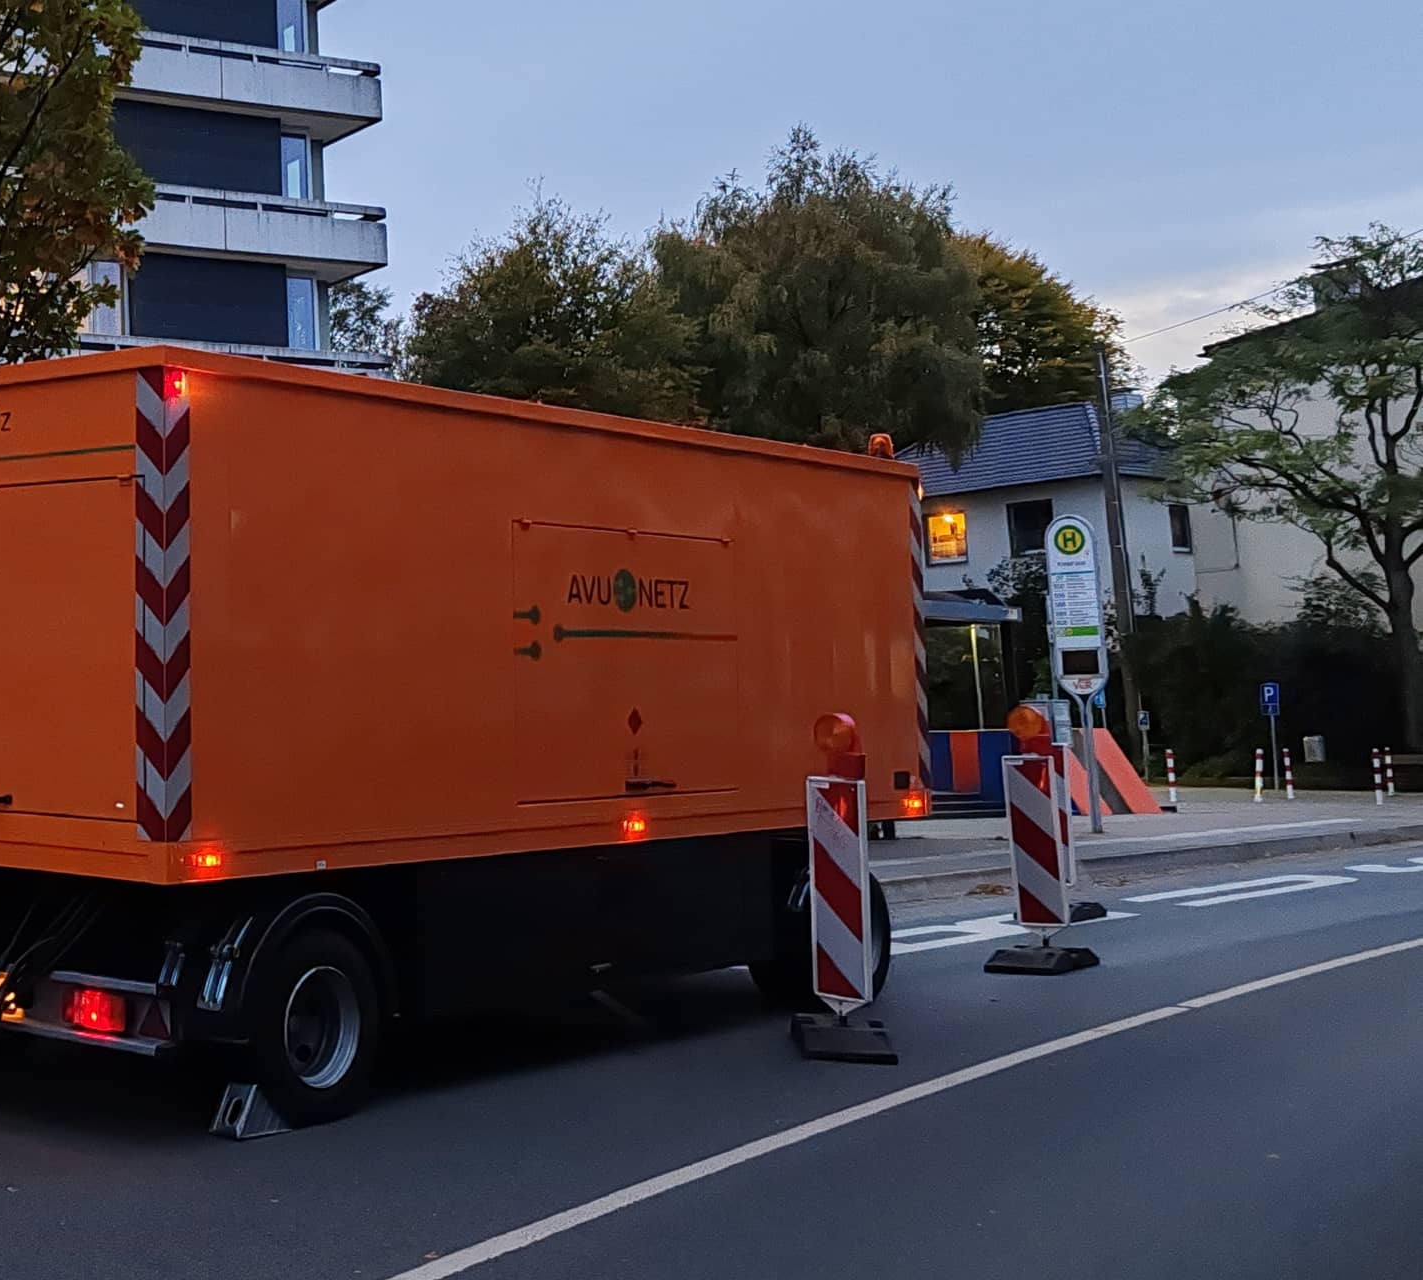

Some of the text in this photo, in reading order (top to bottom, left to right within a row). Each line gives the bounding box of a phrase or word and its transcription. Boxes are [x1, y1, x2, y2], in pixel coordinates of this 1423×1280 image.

[1063, 532, 1076, 548] H
[567, 574, 690, 609] AVU NETZ
[1263, 686, 1274, 702] P
